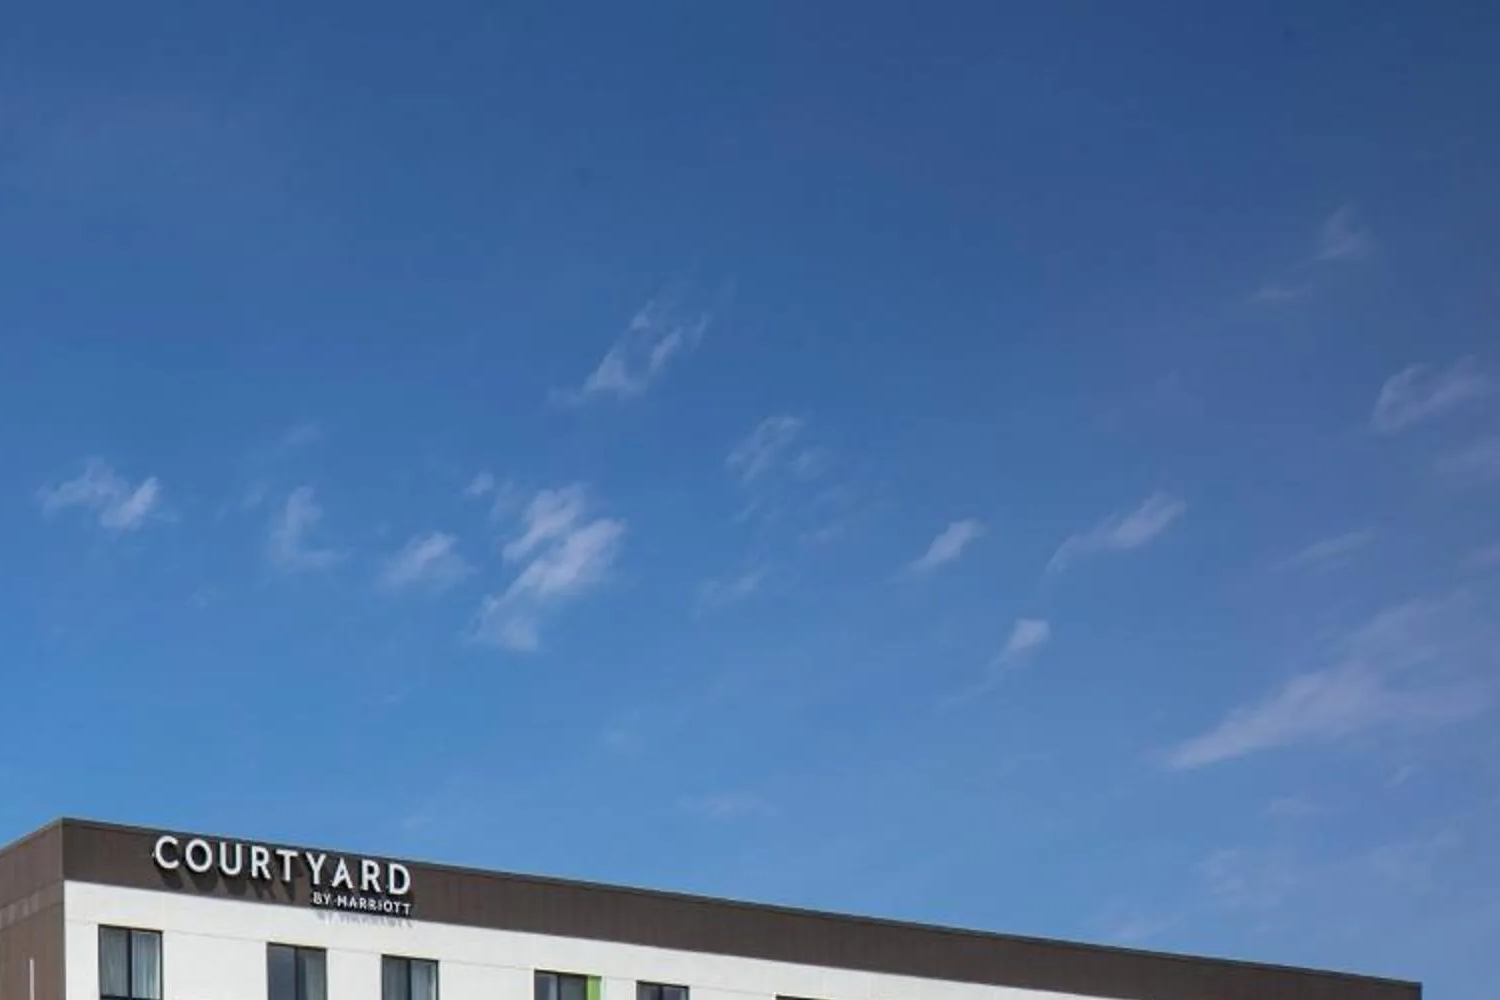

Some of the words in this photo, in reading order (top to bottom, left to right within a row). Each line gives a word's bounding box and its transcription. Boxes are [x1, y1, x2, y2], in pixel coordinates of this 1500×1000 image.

[155, 835, 411, 895] COURTYARD
[313, 891, 331, 905] BY
[337, 895, 412, 916] MARRIOTT
